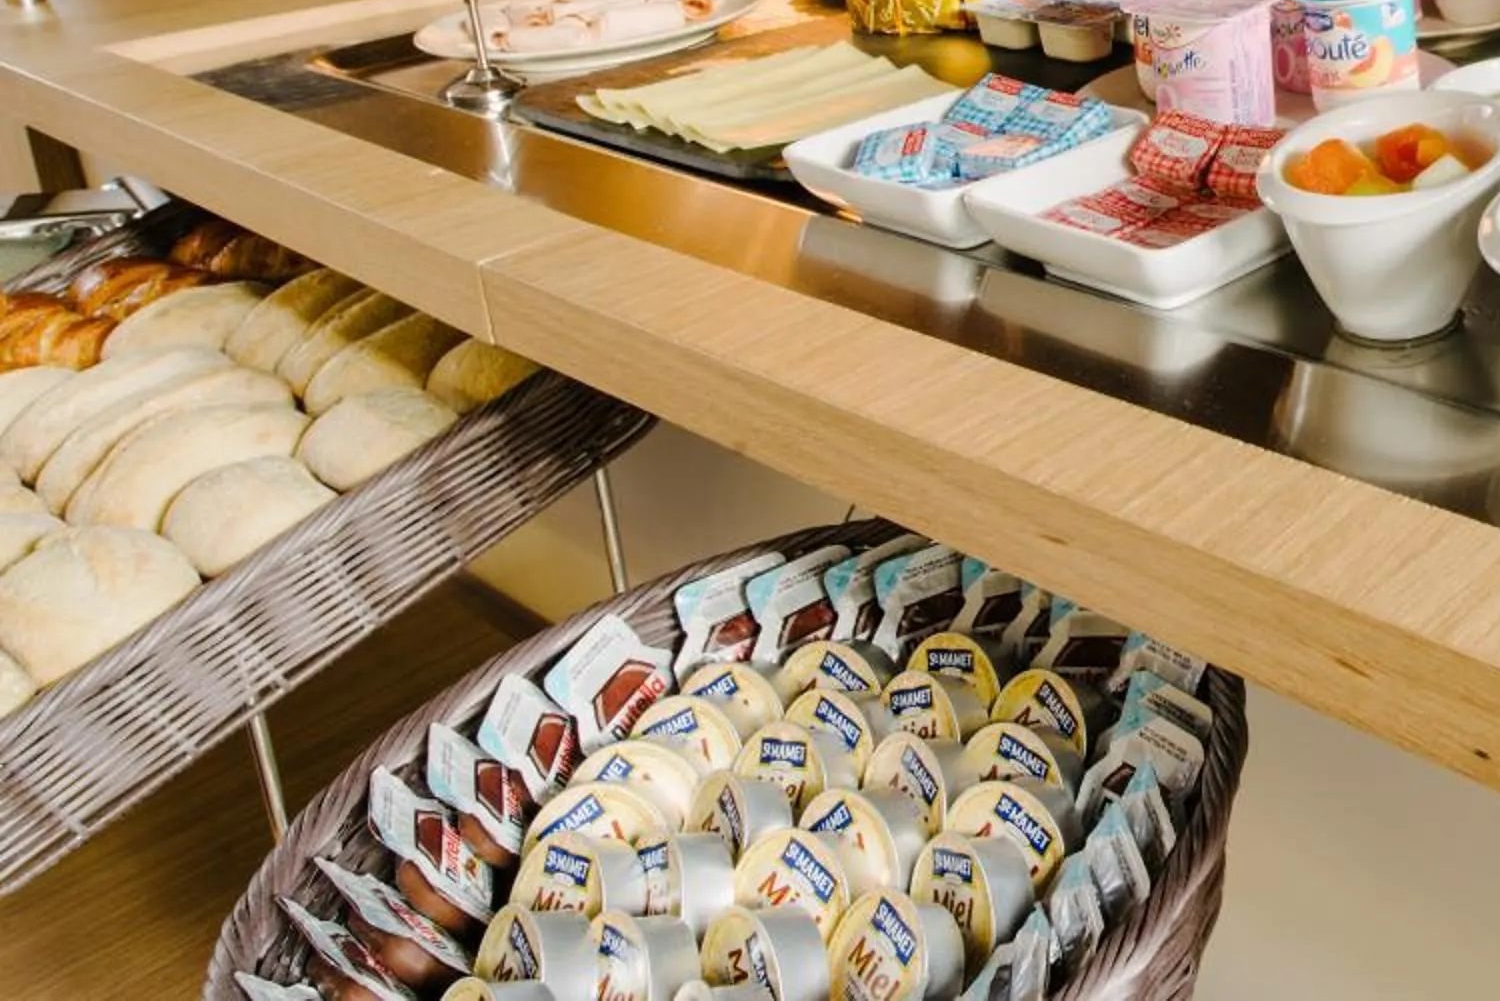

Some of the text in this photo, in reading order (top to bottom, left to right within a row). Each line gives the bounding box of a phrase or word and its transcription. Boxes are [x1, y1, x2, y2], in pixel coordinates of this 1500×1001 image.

[939, 653, 973, 670] MAMET
[611, 677, 666, 740] nutella
[901, 689, 932, 708] MAMET
[1045, 694, 1077, 735] MAMET
[827, 705, 862, 747] MAMET
[771, 742, 806, 760] MAMET
[1010, 742, 1049, 777] MAMET
[1007, 805, 1051, 851] MAMET
[794, 851, 836, 897] MAMET
[944, 855, 973, 879] MAMET
[884, 913, 917, 958] MAMET
[848, 935, 901, 1001] Miel
